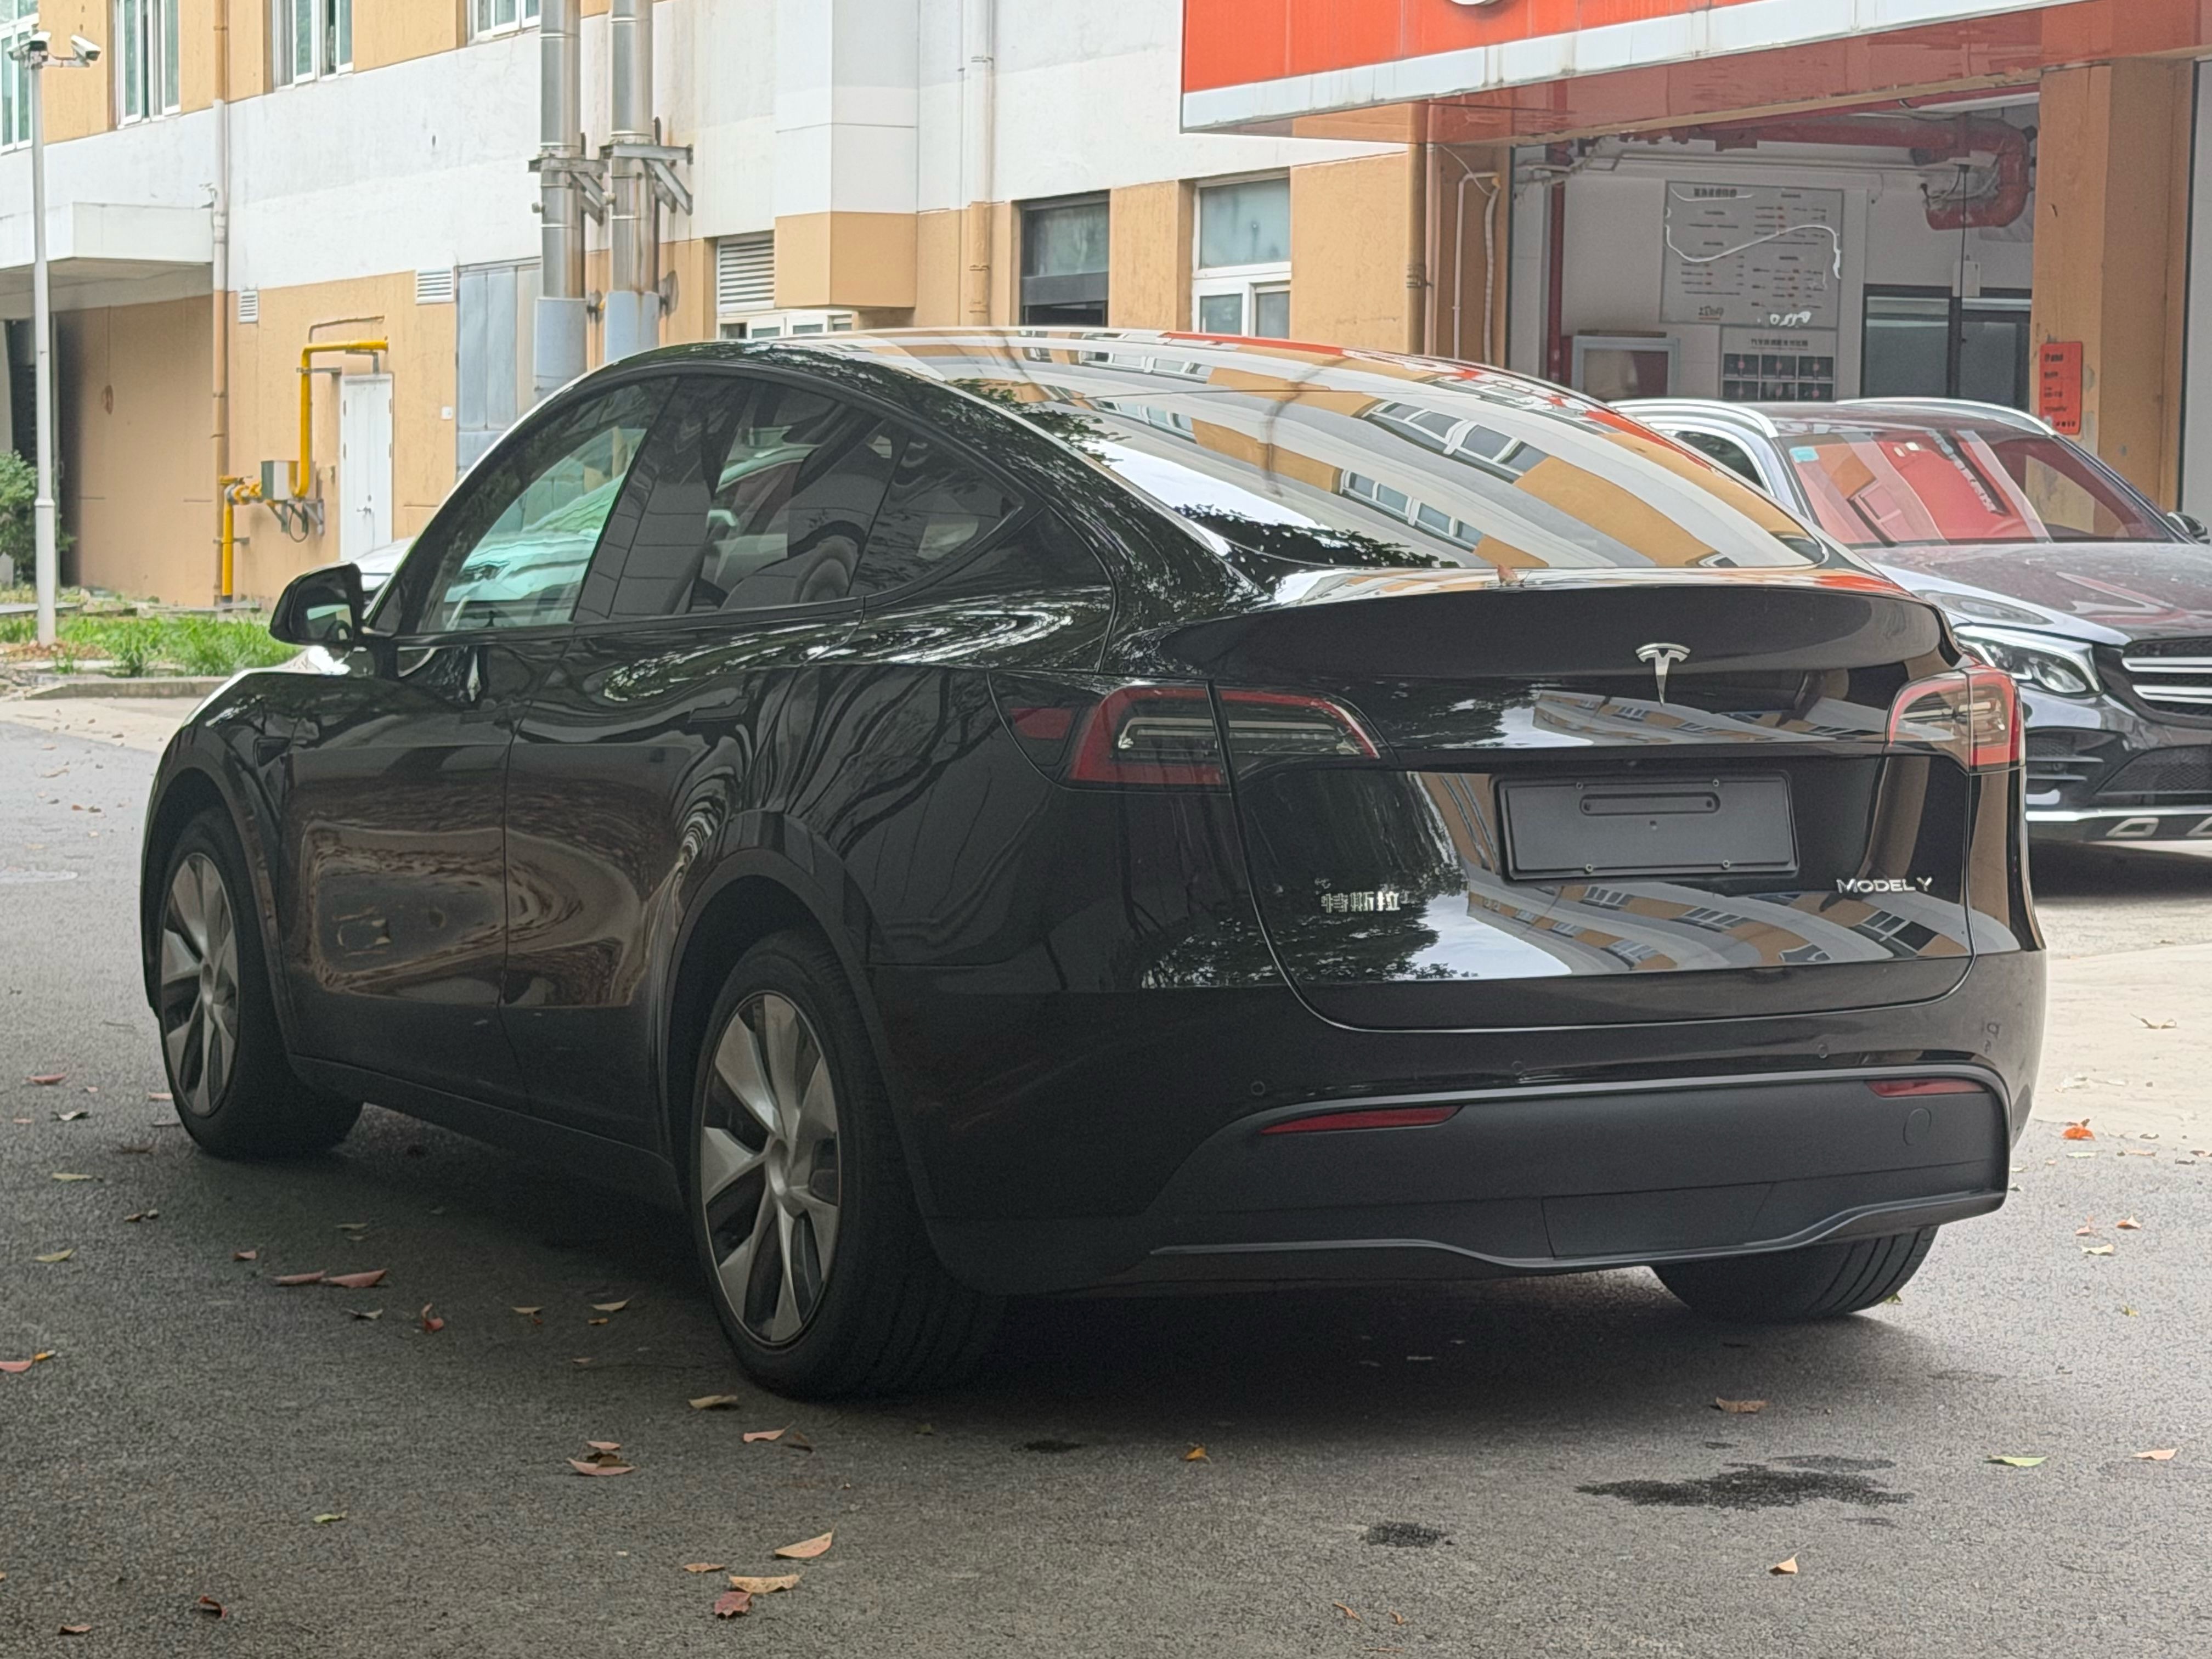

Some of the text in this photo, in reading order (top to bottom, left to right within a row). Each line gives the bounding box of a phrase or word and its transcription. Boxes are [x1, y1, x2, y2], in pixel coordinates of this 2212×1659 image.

[1836, 876, 1933, 893] MODEL Y
[1321, 891, 1401, 913] 特斯拉
